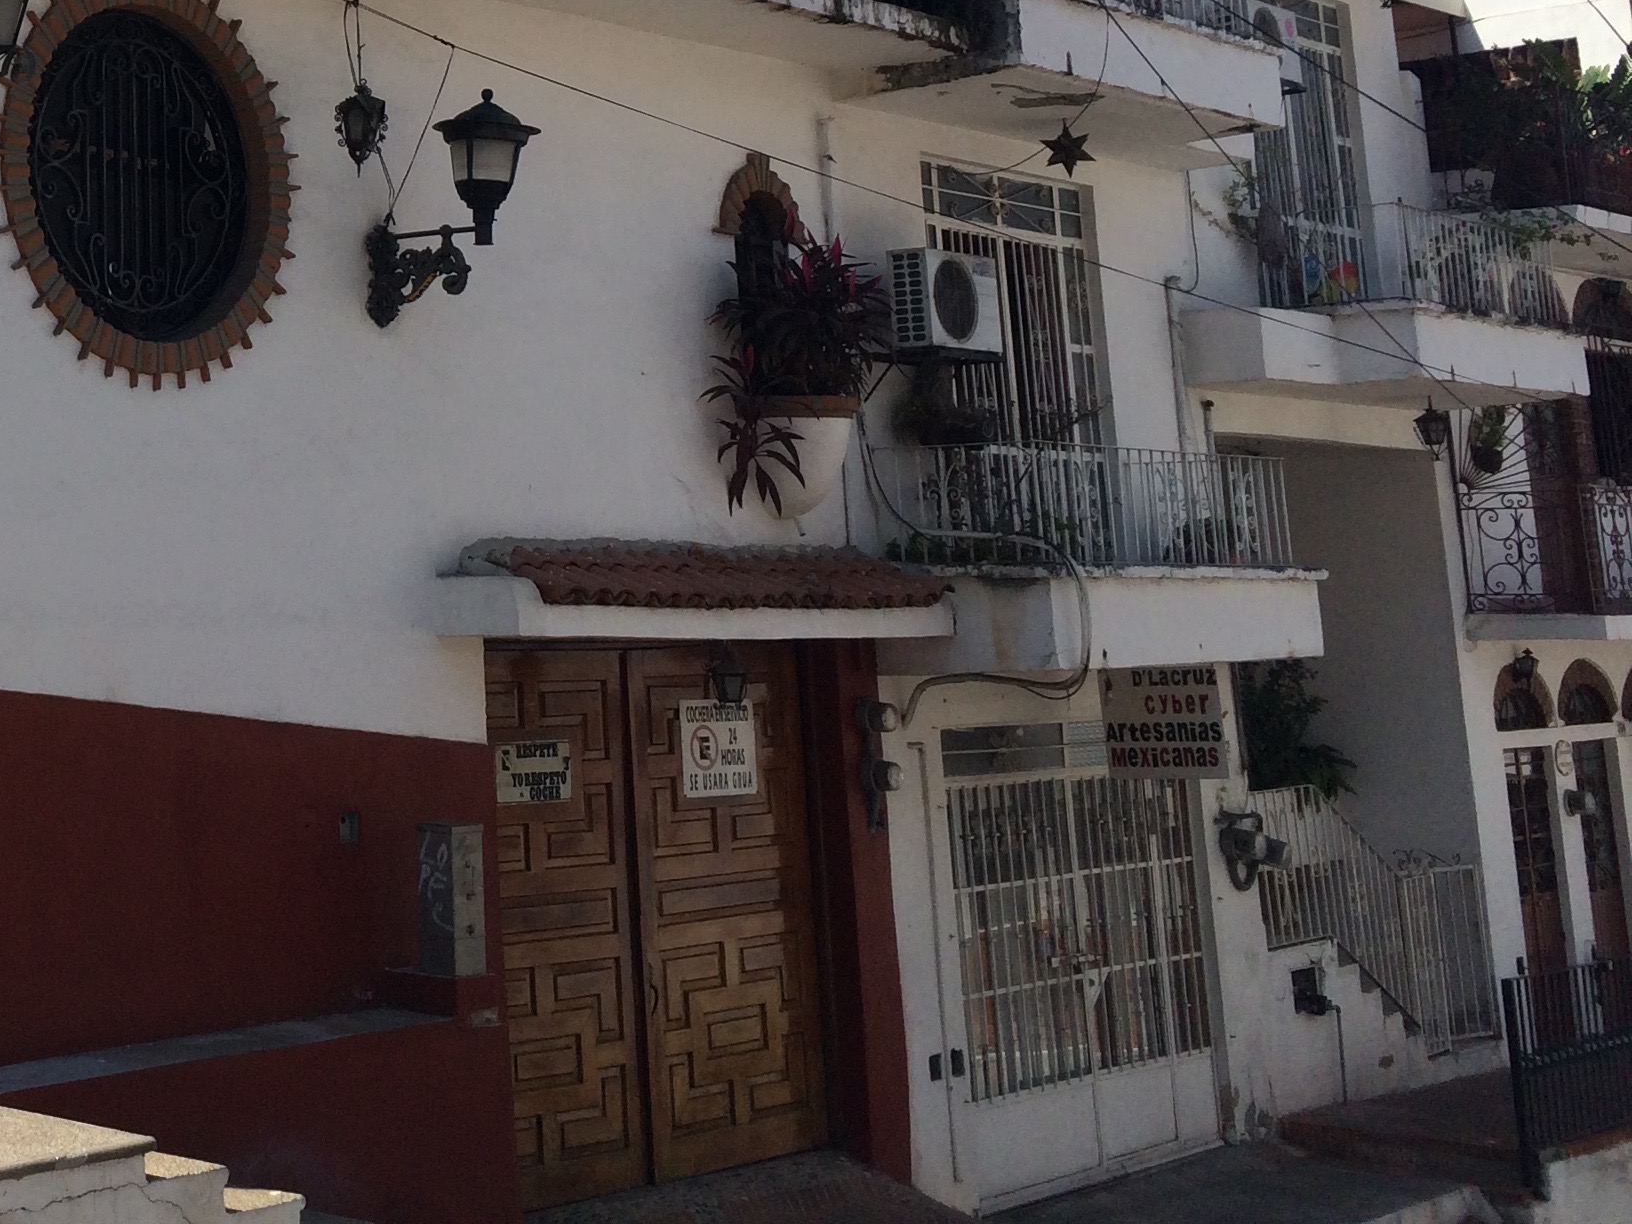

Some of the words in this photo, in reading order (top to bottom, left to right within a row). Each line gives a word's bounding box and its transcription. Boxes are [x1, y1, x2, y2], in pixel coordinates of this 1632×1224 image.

[728, 727, 737, 744] 24
[1106, 721, 1222, 743] Artesanias
[515, 742, 558, 758] RESPETE
[720, 748, 745, 766] HORAS
[1110, 746, 1220, 768] Mexicanas
[511, 772, 523, 787] YO
[524, 771, 566, 786] RESPETO
[689, 773, 699, 791] SE
[702, 772, 729, 790] USARA
[732, 771, 753, 789] GRUA
